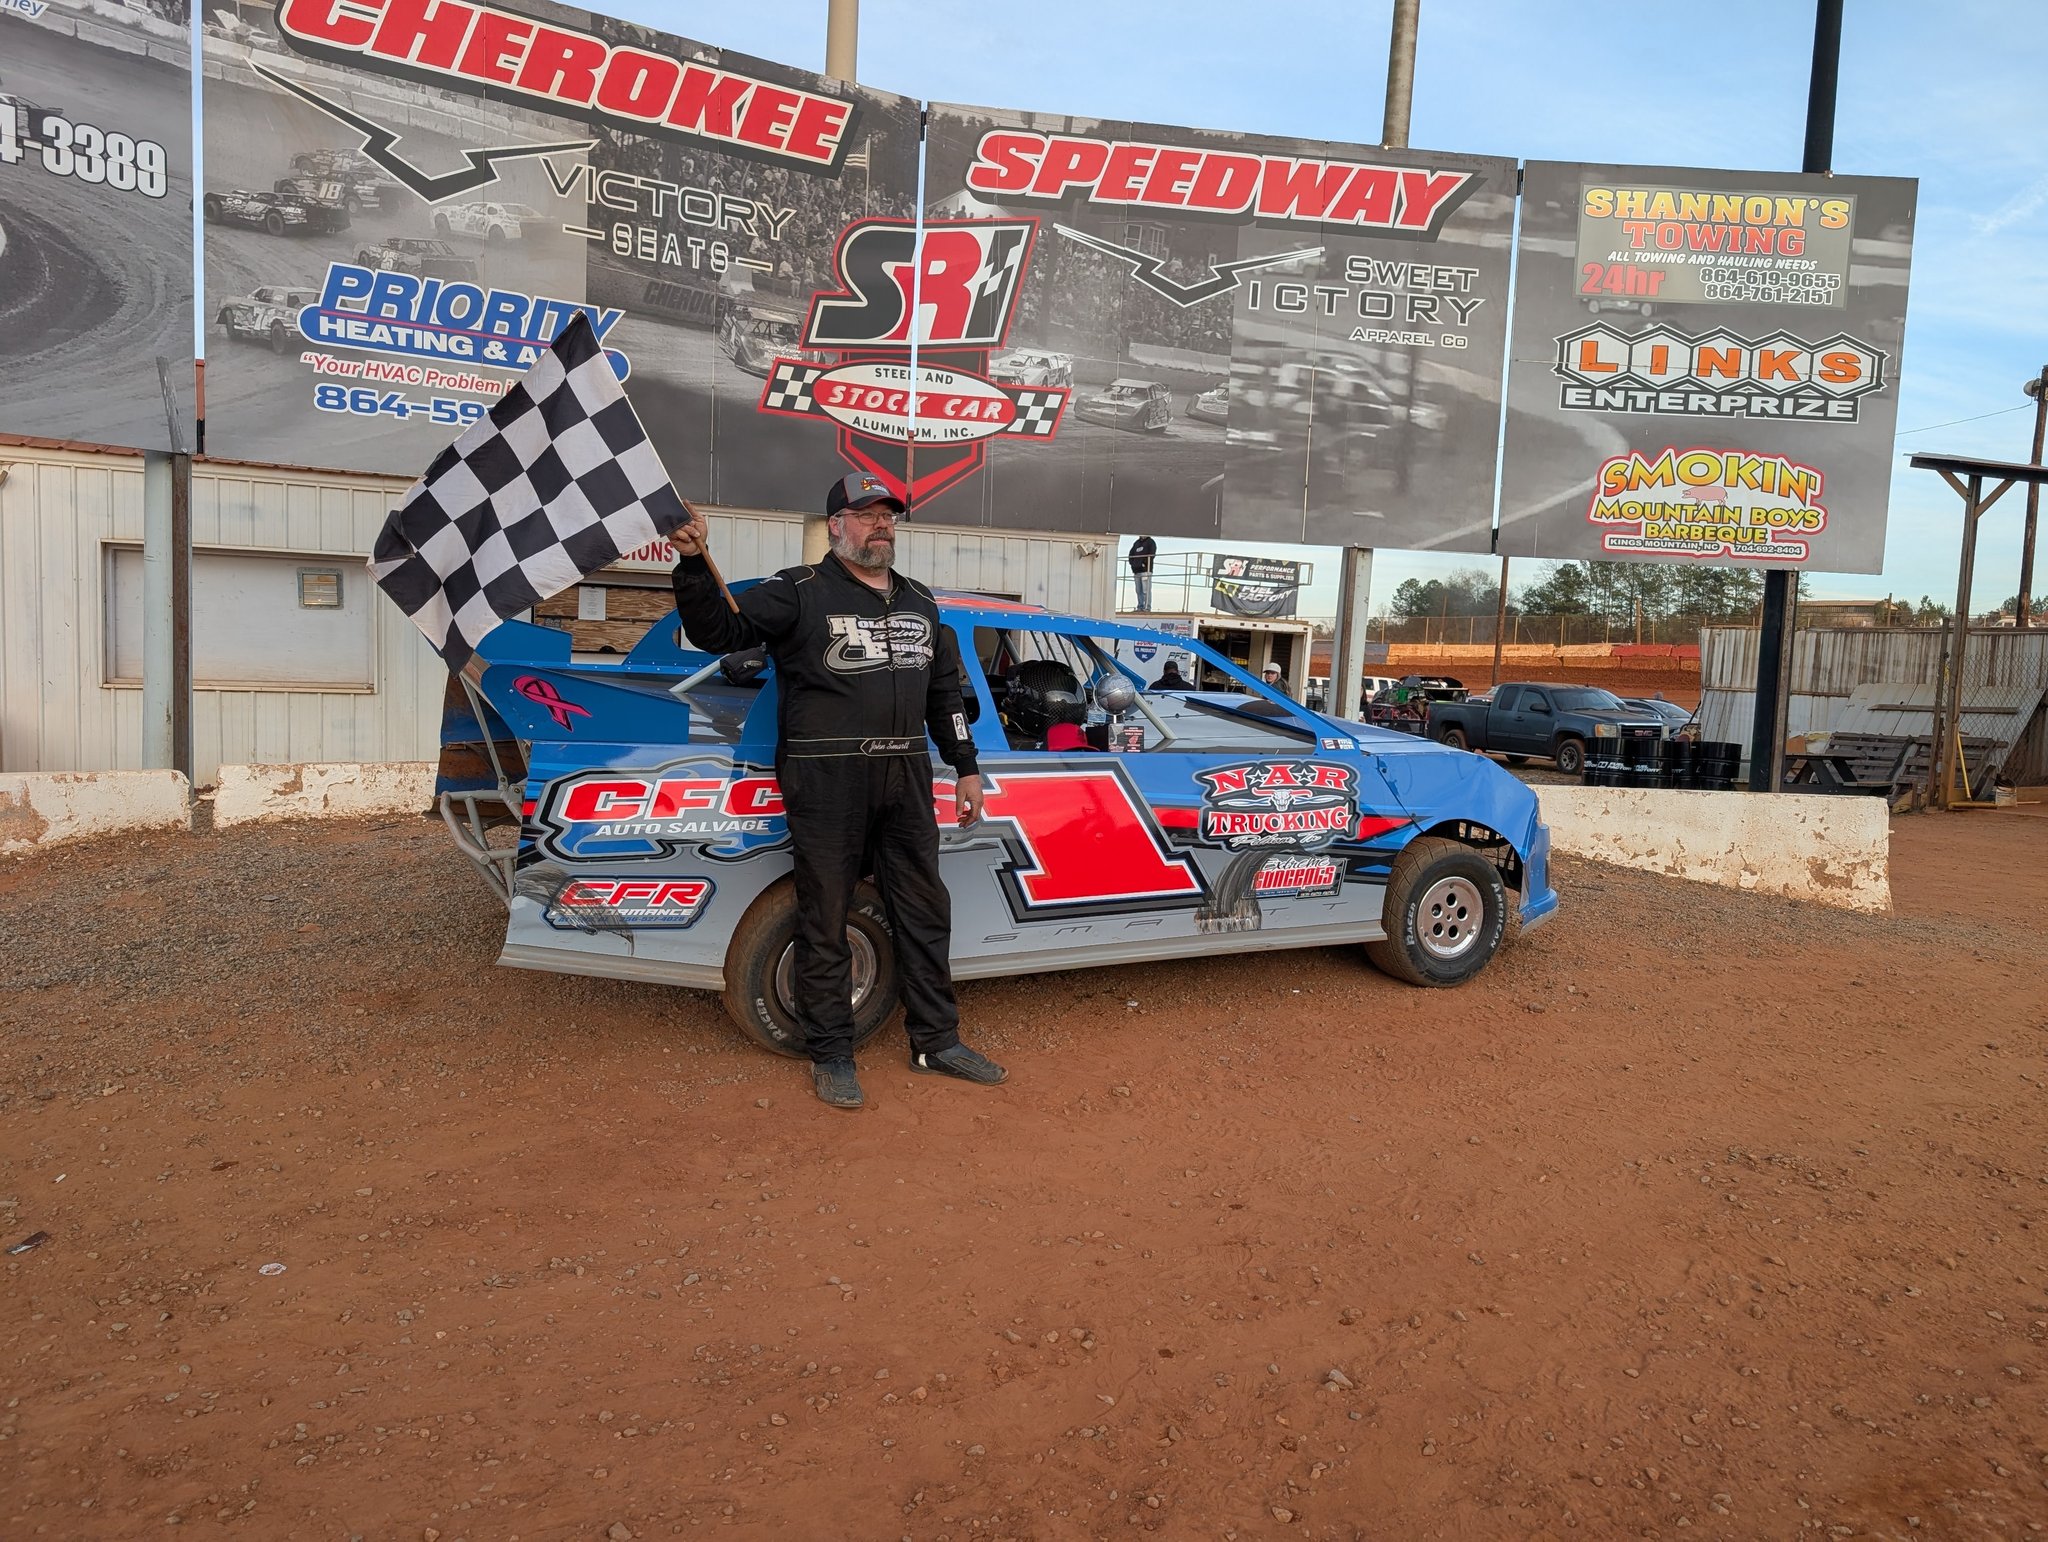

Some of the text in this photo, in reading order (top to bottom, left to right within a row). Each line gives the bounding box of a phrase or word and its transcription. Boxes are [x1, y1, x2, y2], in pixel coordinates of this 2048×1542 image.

[278, 0, 854, 165] CHEROKEE
[967, 130, 1473, 231] SPEEDWAY
[541, 157, 797, 242] VICTORY
[1584, 188, 1850, 229] SHANNON'S
[612, 222, 729, 273] SEATS
[1622, 220, 1806, 257] TOWING
[1345, 255, 1480, 293] SWEET
[1608, 251, 1818, 271] ALL TOWING AND HAULING NEEDS
[1580, 262, 1666, 297] 24hr
[1699, 266, 1841, 290] 864-619-9655
[318, 262, 627, 344] PRIORITY
[1704, 284, 1835, 305] 864-761-2151
[319, 316, 474, 356] HEATING
[483, 340, 509, 361] &
[1349, 327, 1435, 347] APPAREL
[1578, 339, 1862, 384] LINKS
[366, 365, 420, 384] HVAC
[426, 370, 501, 394] Problem
[925, 371, 954, 385] AND
[828, 386, 1003, 420] STOCK CAR
[1565, 387, 1855, 418] ENTERPRIZE
[944, 427, 975, 438] INC.
[1603, 451, 1818, 508] SMOKIN'
[1594, 498, 1822, 530] MOUNTAIN BOYS
[1609, 537, 1643, 548] KINGS
[1644, 539, 1701, 551] MOUNTAIN,
[1702, 541, 1721, 552] NC
[1645, 522, 1768, 545] BARBEQUE
[1249, 564, 1295, 574] PERFORMANCE
[1238, 588, 1294, 603] FACTORY
[1241, 585, 1274, 595] FUEL
[595, 819, 772, 836] AUTO SALVAGE
[1208, 802, 1352, 837] TRUCKING
